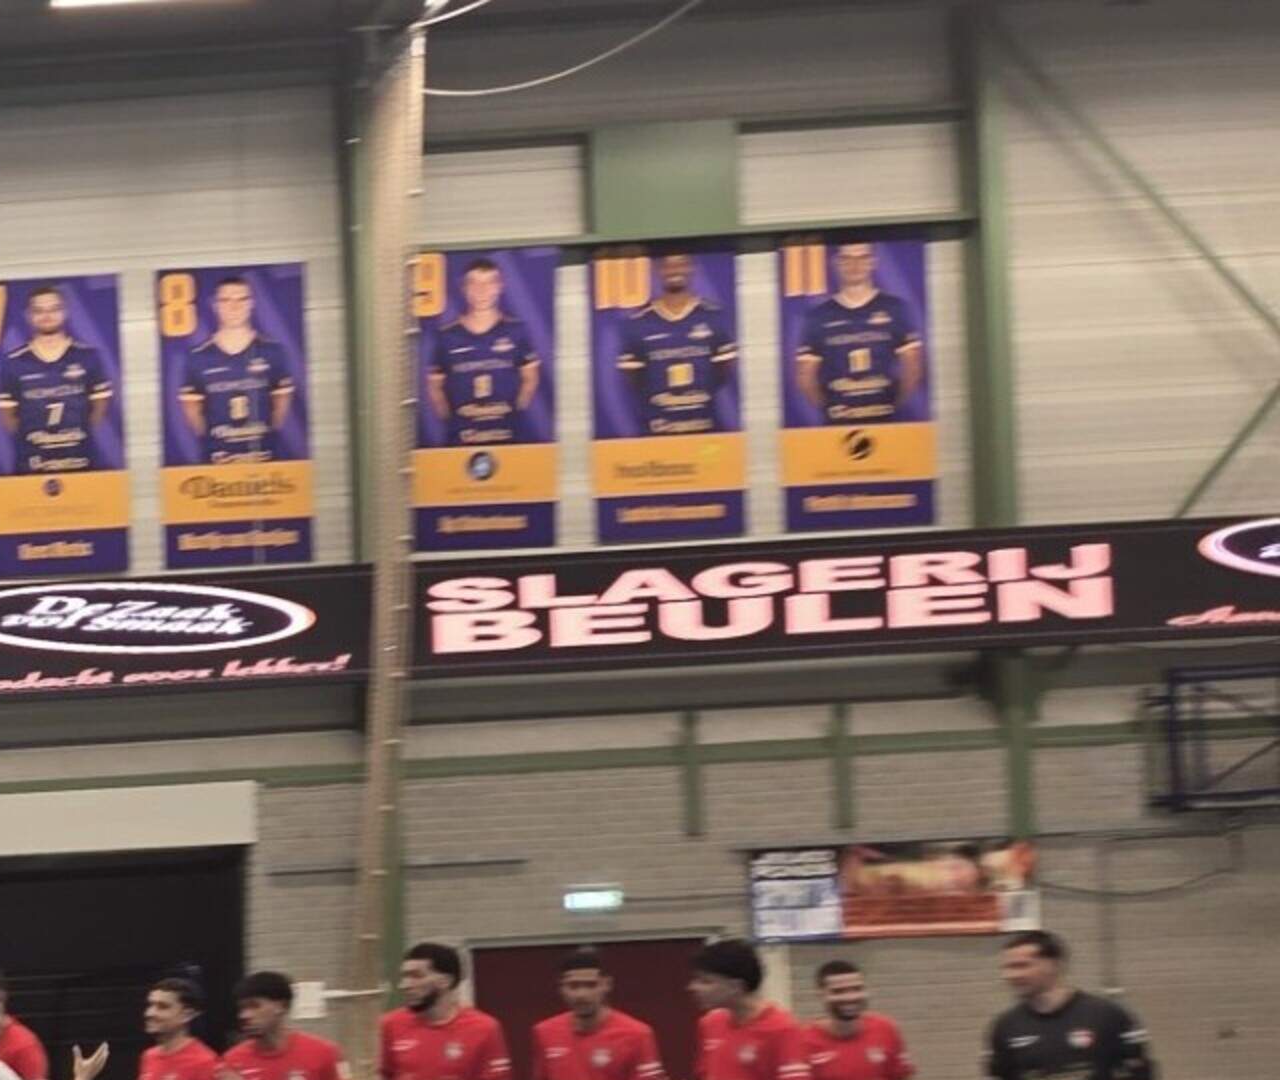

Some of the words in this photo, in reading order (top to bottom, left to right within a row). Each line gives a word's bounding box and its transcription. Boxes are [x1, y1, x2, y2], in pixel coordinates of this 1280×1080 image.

[159, 273, 196, 337] 8
[426, 543, 1112, 614] SLAGERIJ
[430, 576, 1114, 654] BEULEN
